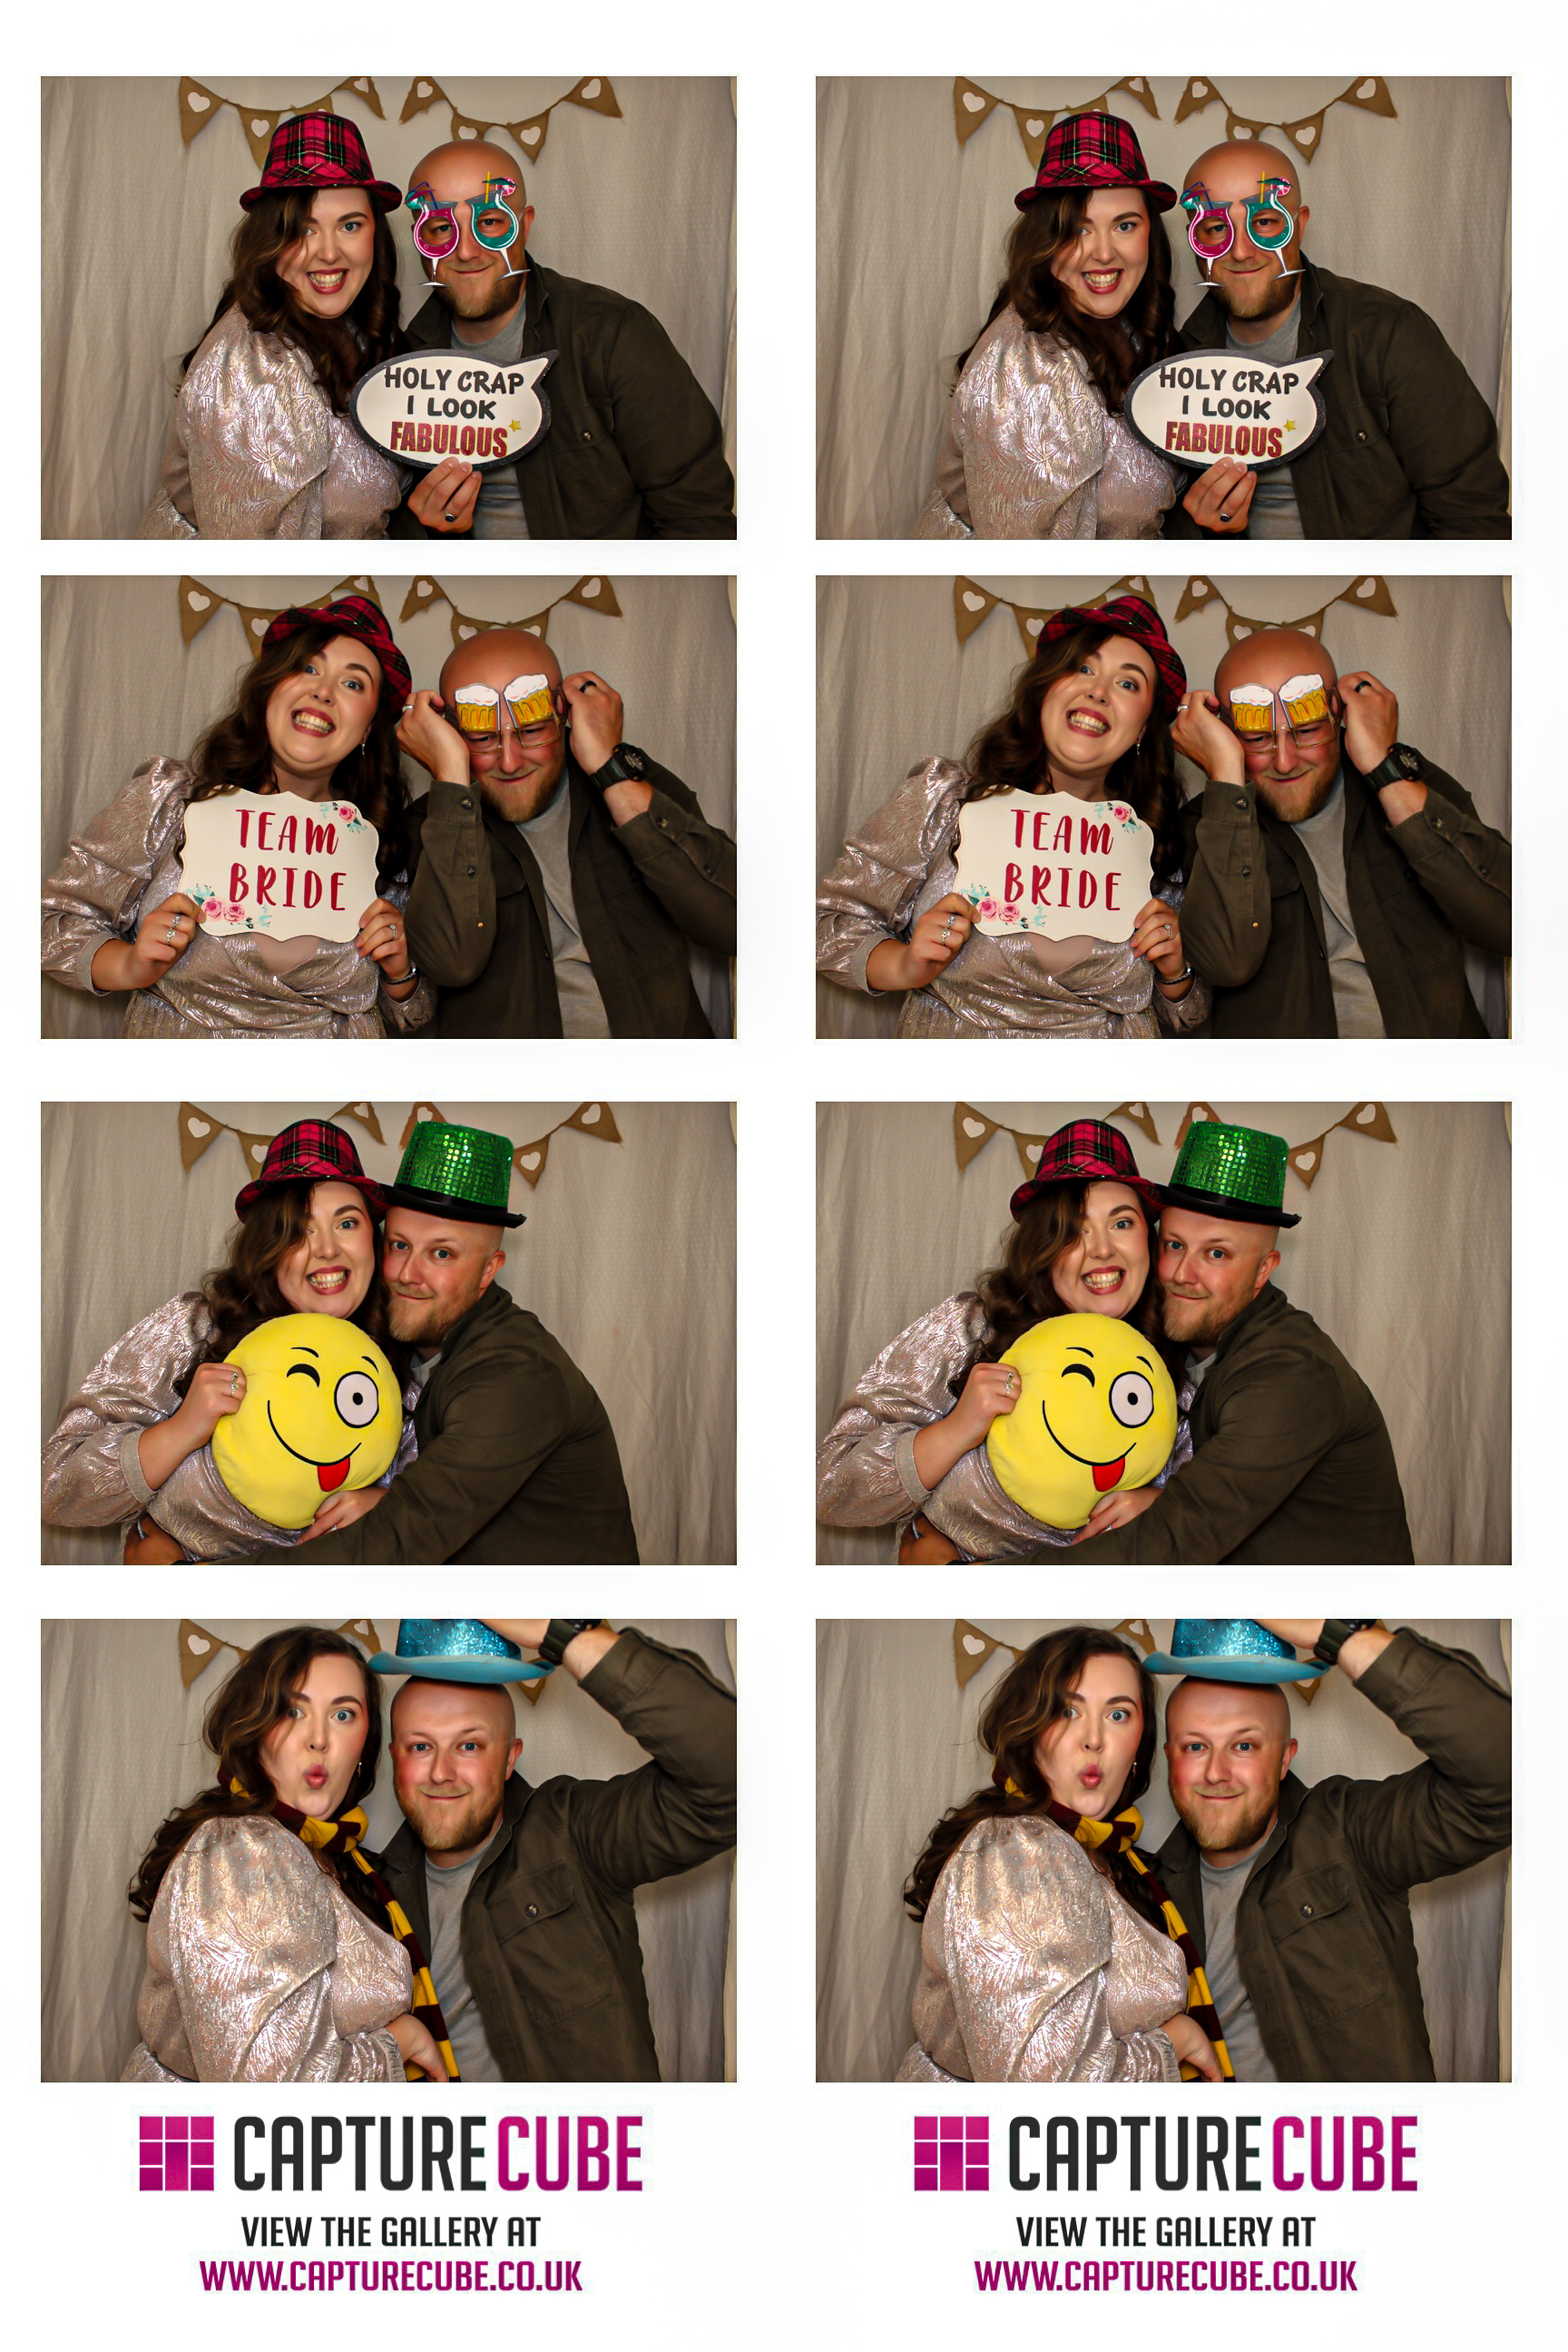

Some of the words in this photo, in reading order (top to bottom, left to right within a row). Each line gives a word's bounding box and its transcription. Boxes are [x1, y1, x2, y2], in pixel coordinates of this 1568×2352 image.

[385, 367, 452, 391] HOLY
[457, 370, 524, 395] CRAP
[1160, 367, 1227, 391] HOLY
[1232, 370, 1299, 395] CRAP
[407, 395, 415, 415] I
[427, 397, 497, 420] LOOK
[1181, 395, 1190, 415] I
[1202, 397, 1272, 420] LOOK
[390, 421, 508, 458] FABULOUS
[1165, 421, 1283, 458] FABULOUS
[236, 808, 339, 855] TEAM
[1011, 808, 1114, 855] TEAM
[229, 862, 347, 911] BRIDE
[1004, 862, 1122, 911] BRIDE
